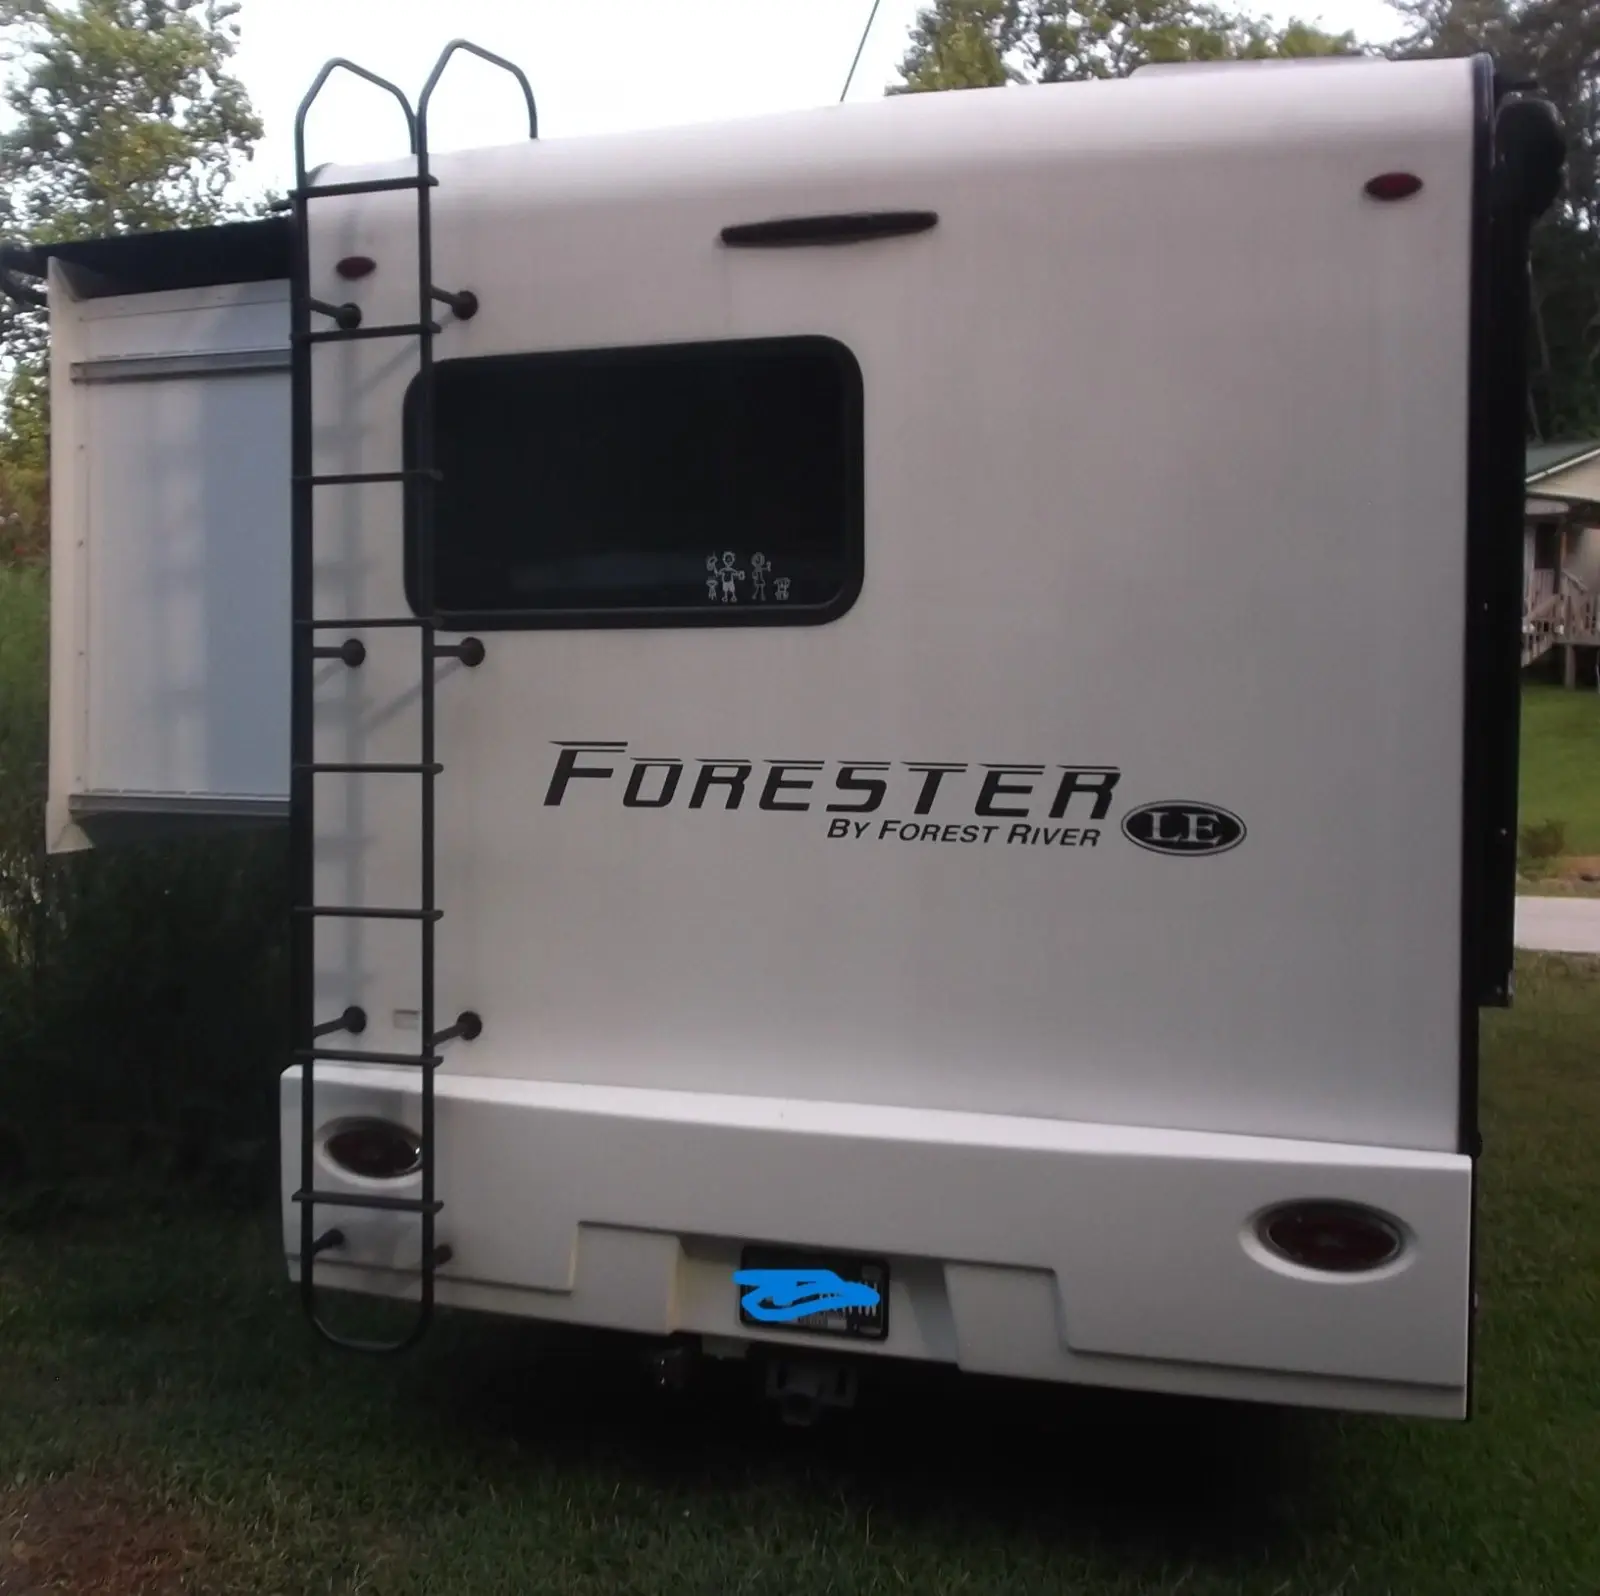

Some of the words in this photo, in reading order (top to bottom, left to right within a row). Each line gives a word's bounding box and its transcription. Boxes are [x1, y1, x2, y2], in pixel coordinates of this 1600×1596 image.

[543, 741, 1121, 819] FORESTER
[827, 818, 870, 840] BY
[878, 820, 999, 843] FOREST
[1006, 824, 1102, 848] RIVER
[1145, 811, 1221, 845] LE
